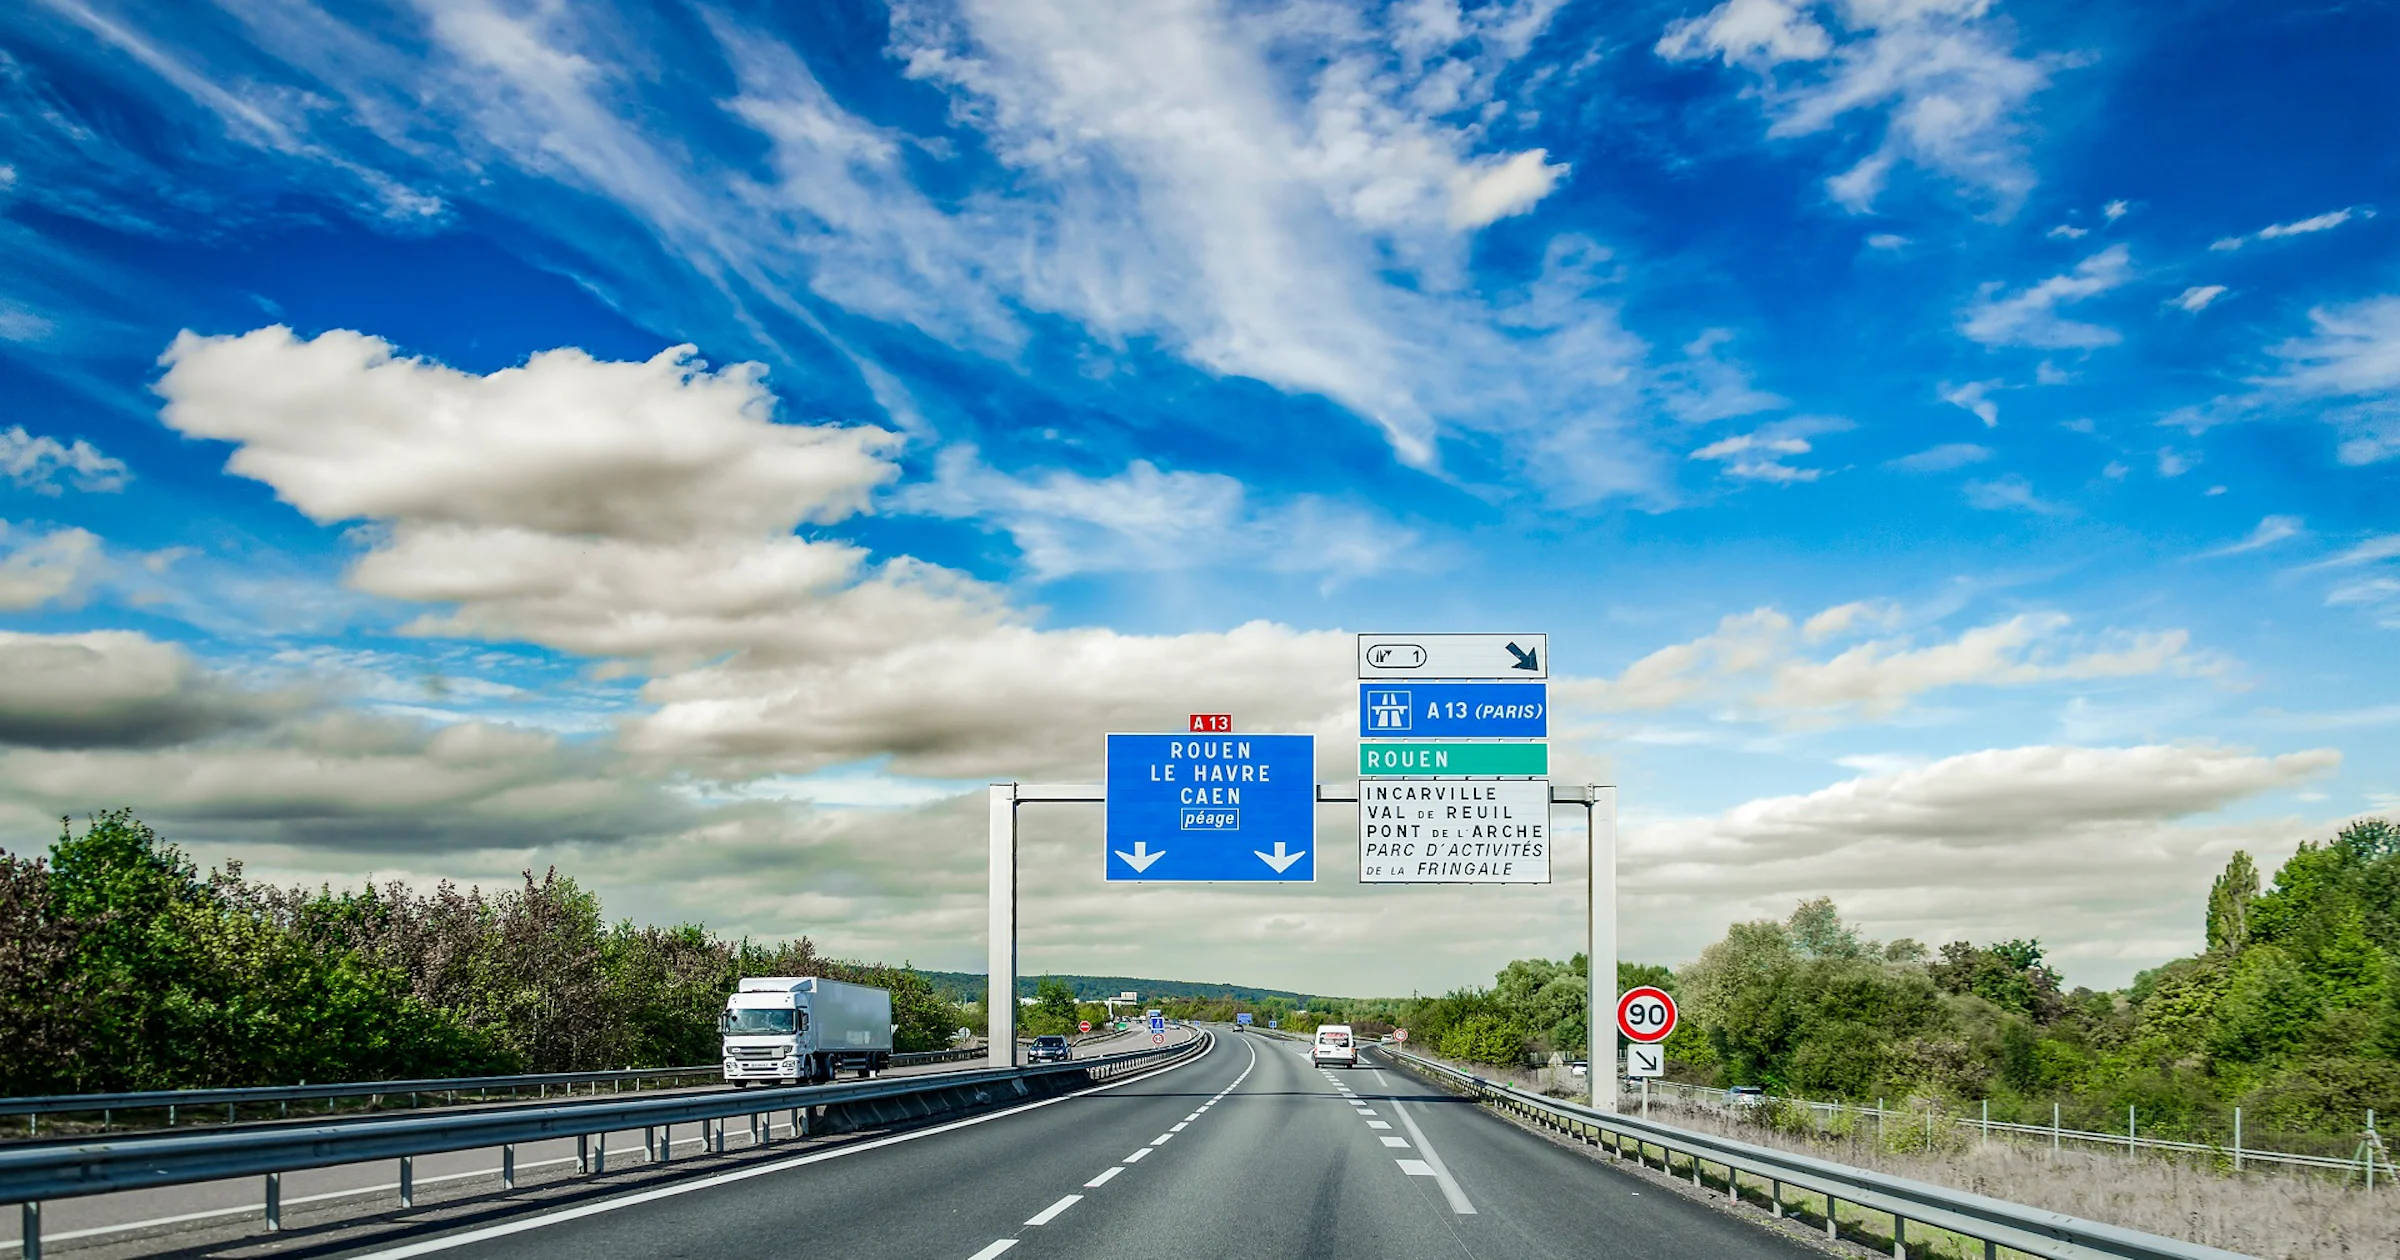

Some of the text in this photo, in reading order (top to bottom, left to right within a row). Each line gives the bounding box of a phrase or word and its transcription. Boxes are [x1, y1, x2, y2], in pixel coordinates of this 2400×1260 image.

[1412, 650, 1419, 663] 1
[1426, 702, 1543, 720] A 13 (PARIS)
[1193, 716, 1229, 730] A 13
[1170, 742, 1251, 759] ROUEN
[1367, 751, 1448, 768] ROUEN
[1151, 765, 1270, 782] LE HAVRE
[1180, 787, 1241, 805] CAEN
[1366, 787, 1496, 801] INCARVILLE
[1184, 810, 1235, 828] péage
[1367, 805, 1513, 819] VAL DE REUIL
[1367, 824, 1421, 838] PONT
[1432, 829, 1449, 838] DE
[1366, 841, 1543, 857] PARC D'ACTIVITÉS
[1366, 862, 1513, 876] DE LA FRINGALE
[1629, 1003, 1666, 1026] 90
